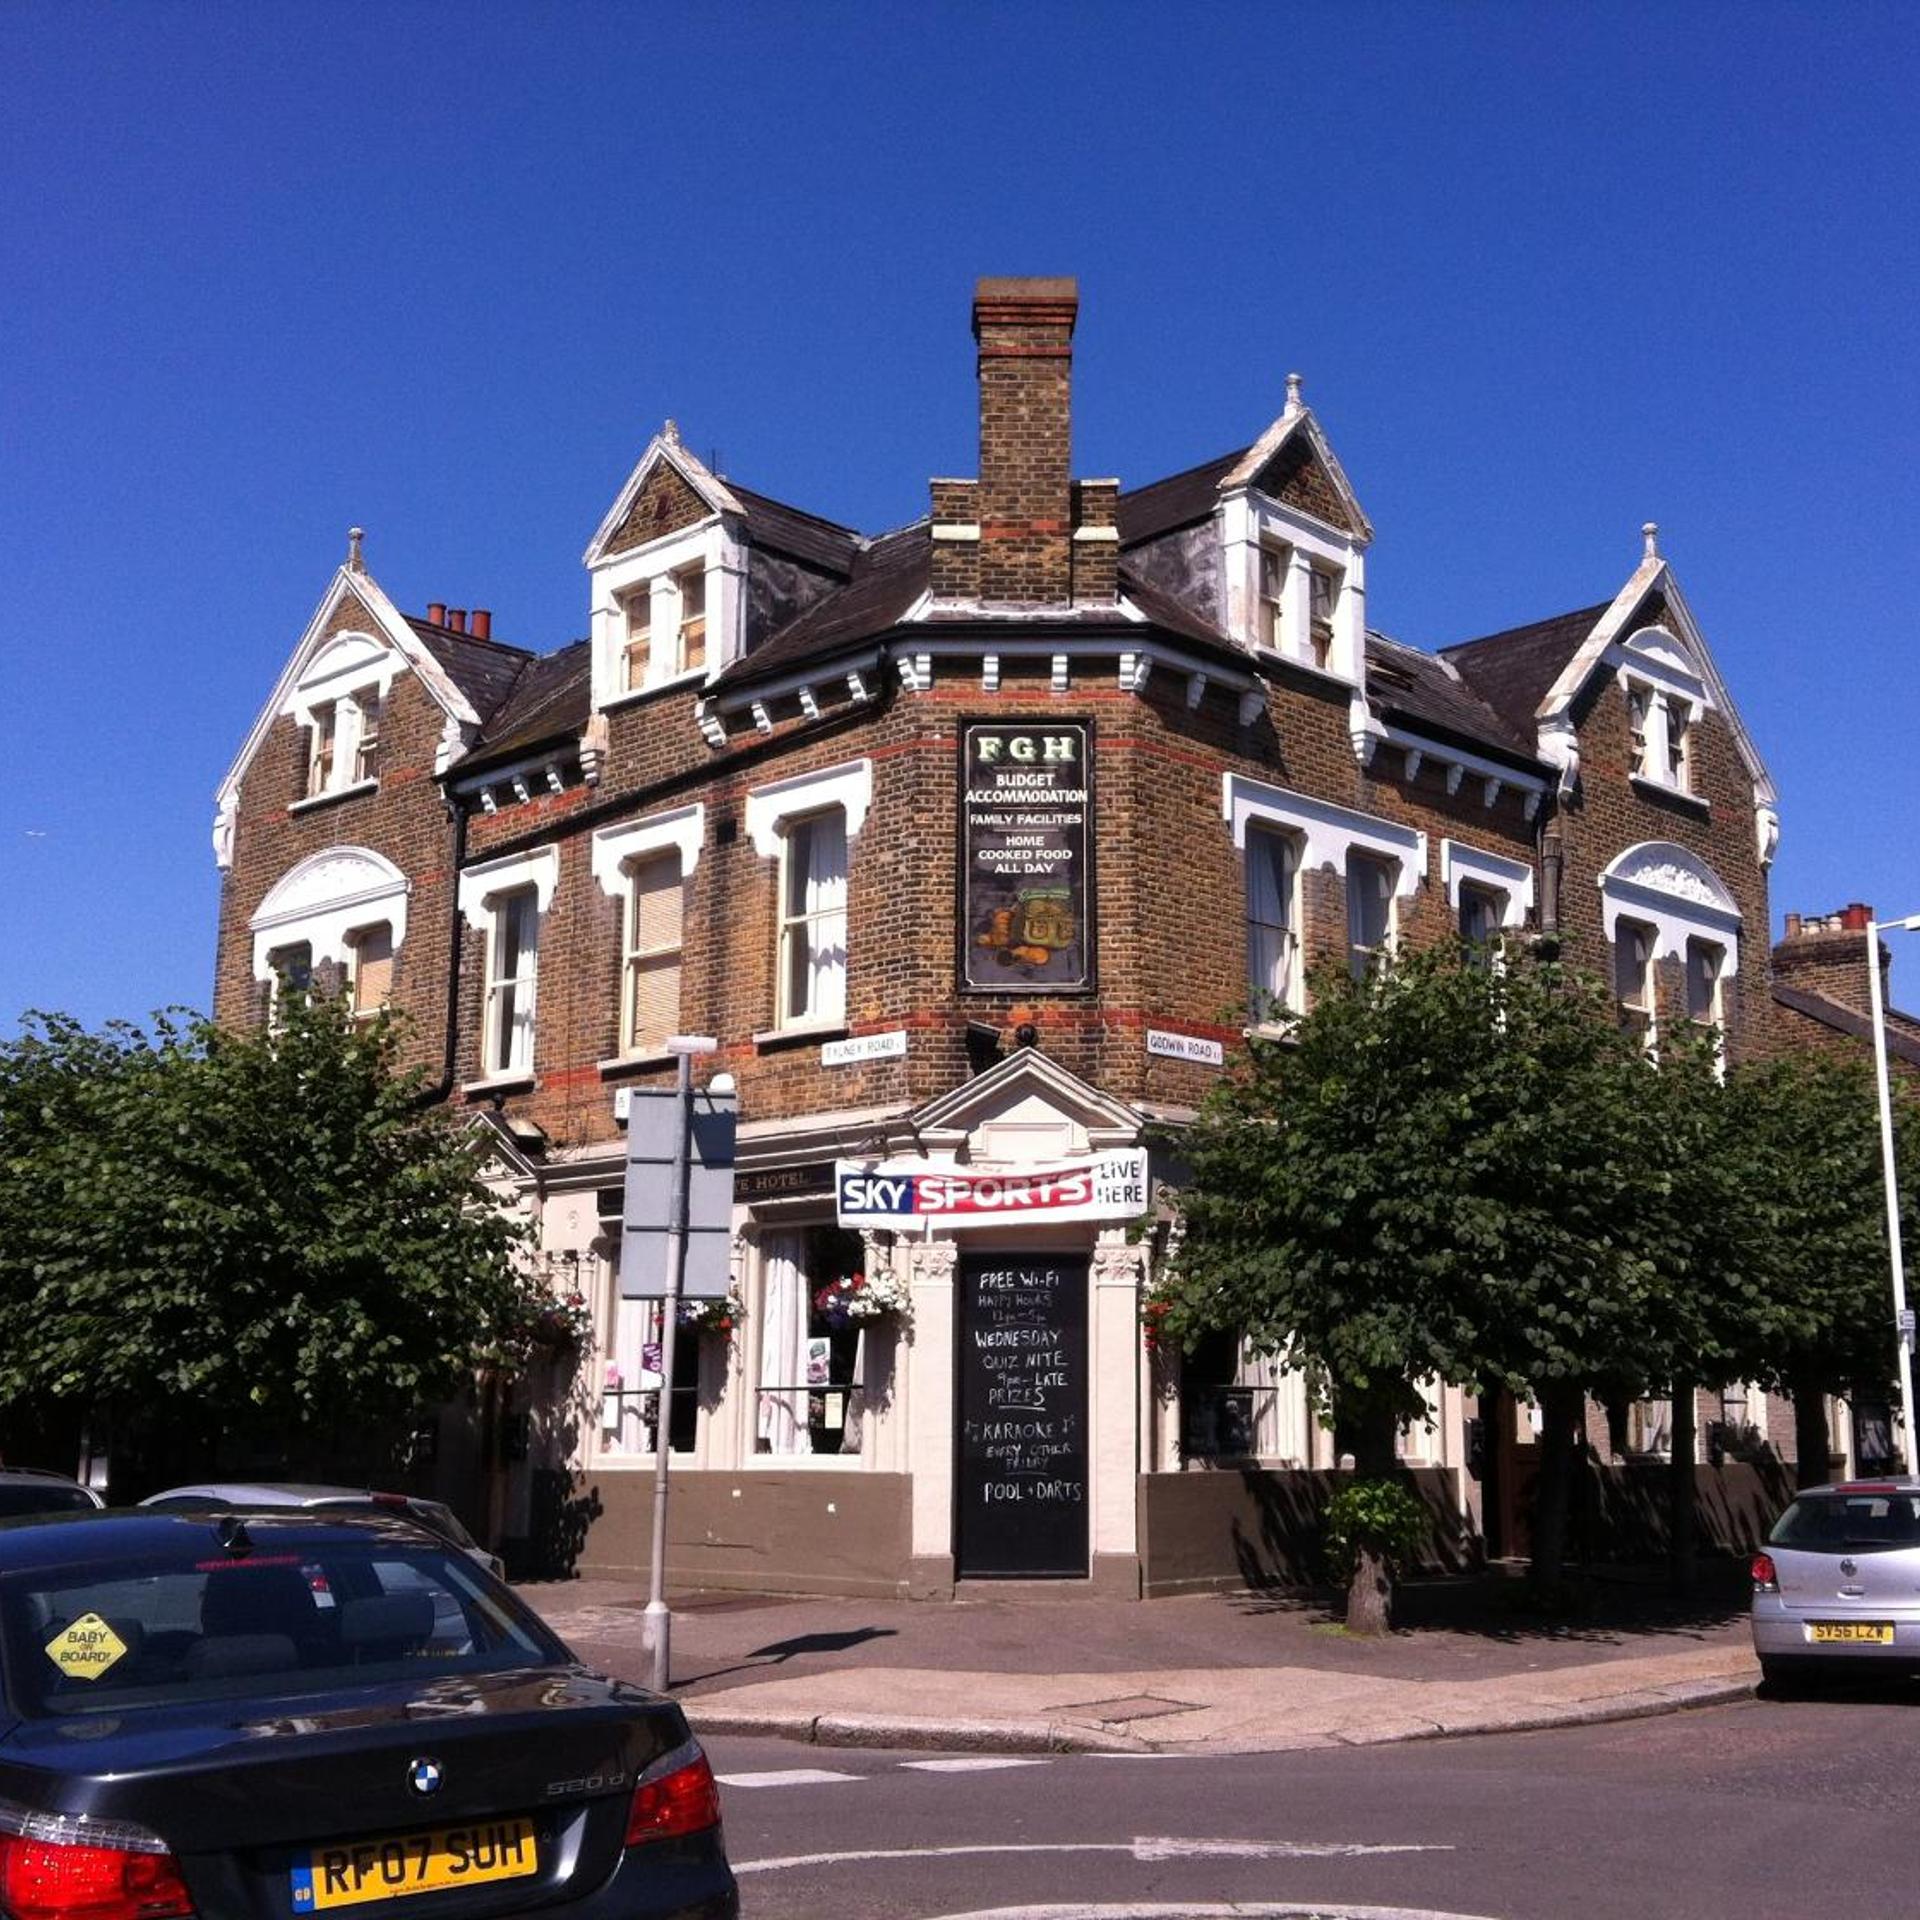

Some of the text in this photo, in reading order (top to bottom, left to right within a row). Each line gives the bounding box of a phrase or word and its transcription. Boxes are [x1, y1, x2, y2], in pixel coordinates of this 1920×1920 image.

[996, 774, 1055, 787] BUDGET
[965, 790, 1088, 803] ACCOMMODATION
[970, 814, 1082, 825] FAMILY FACILITIES
[1006, 836, 1045, 847] HOME
[979, 850, 1073, 861] COOKED FOOD
[995, 863, 1054, 874] ALL DAY
[867, 1038, 895, 1054] ROAD
[1150, 1034, 1184, 1052] GODWIN
[1188, 1041, 1212, 1057] ROAD
[1101, 1160, 1140, 1179] LIVE
[756, 1171, 803, 1190] HOTEL
[843, 1171, 1092, 1211] SKY SPORTS
[1098, 1184, 1143, 1205] HERE
[979, 1271, 1014, 1289] FREE
[975, 1330, 1062, 1348] WEDNESDAY
[983, 1351, 1069, 1369] QUIZ NITE
[1035, 1372, 1069, 1387] LATE
[989, 1387, 1045, 1406] PRIZES
[983, 1422, 1053, 1440] KARAOKE
[984, 1482, 1024, 1503] POOL
[1037, 1480, 1081, 1501] DARTS
[68, 1631, 107, 1643] BABY
[1816, 1625, 1884, 1639] SV56 LZW
[324, 1823, 524, 1896] RF07 SUH
